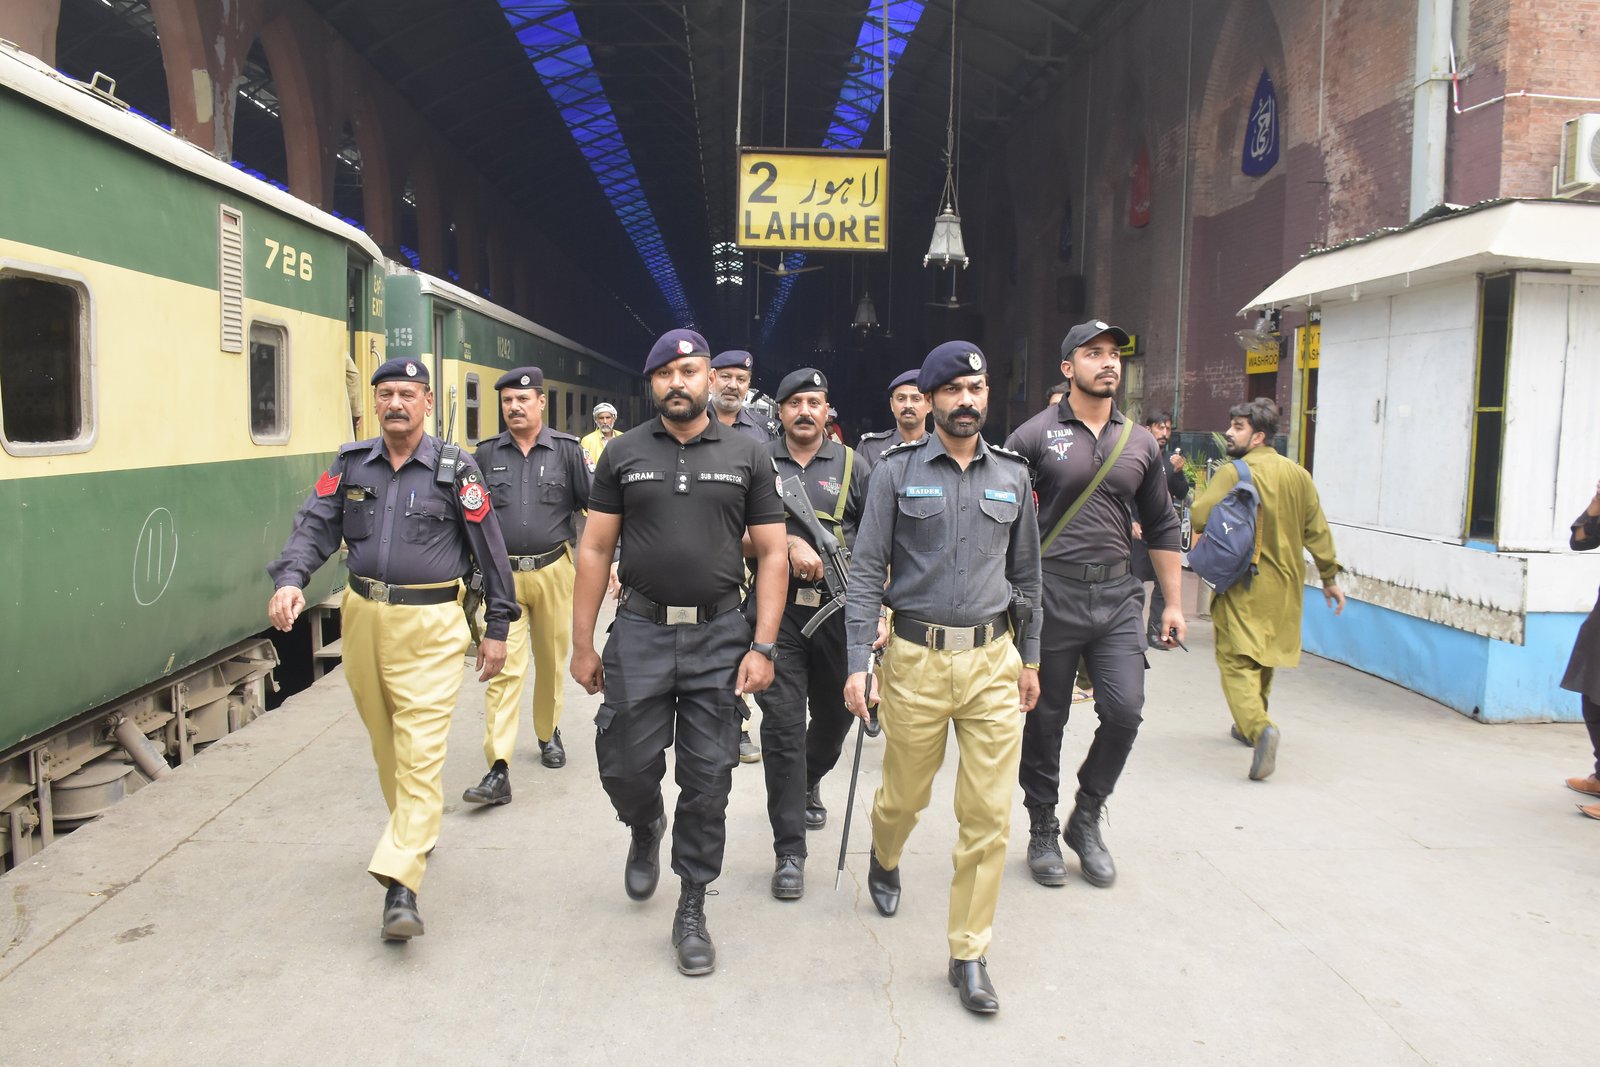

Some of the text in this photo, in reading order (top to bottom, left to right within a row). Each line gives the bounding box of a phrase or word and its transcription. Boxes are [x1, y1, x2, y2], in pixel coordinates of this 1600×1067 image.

[748, 161, 778, 204] 2
[799, 165, 880, 208] لاہور
[744, 210, 881, 243] LAHORE
[264, 237, 313, 281] 726
[628, 472, 654, 482] IKRAM
[700, 472, 743, 484] SUB INSPECTOR
